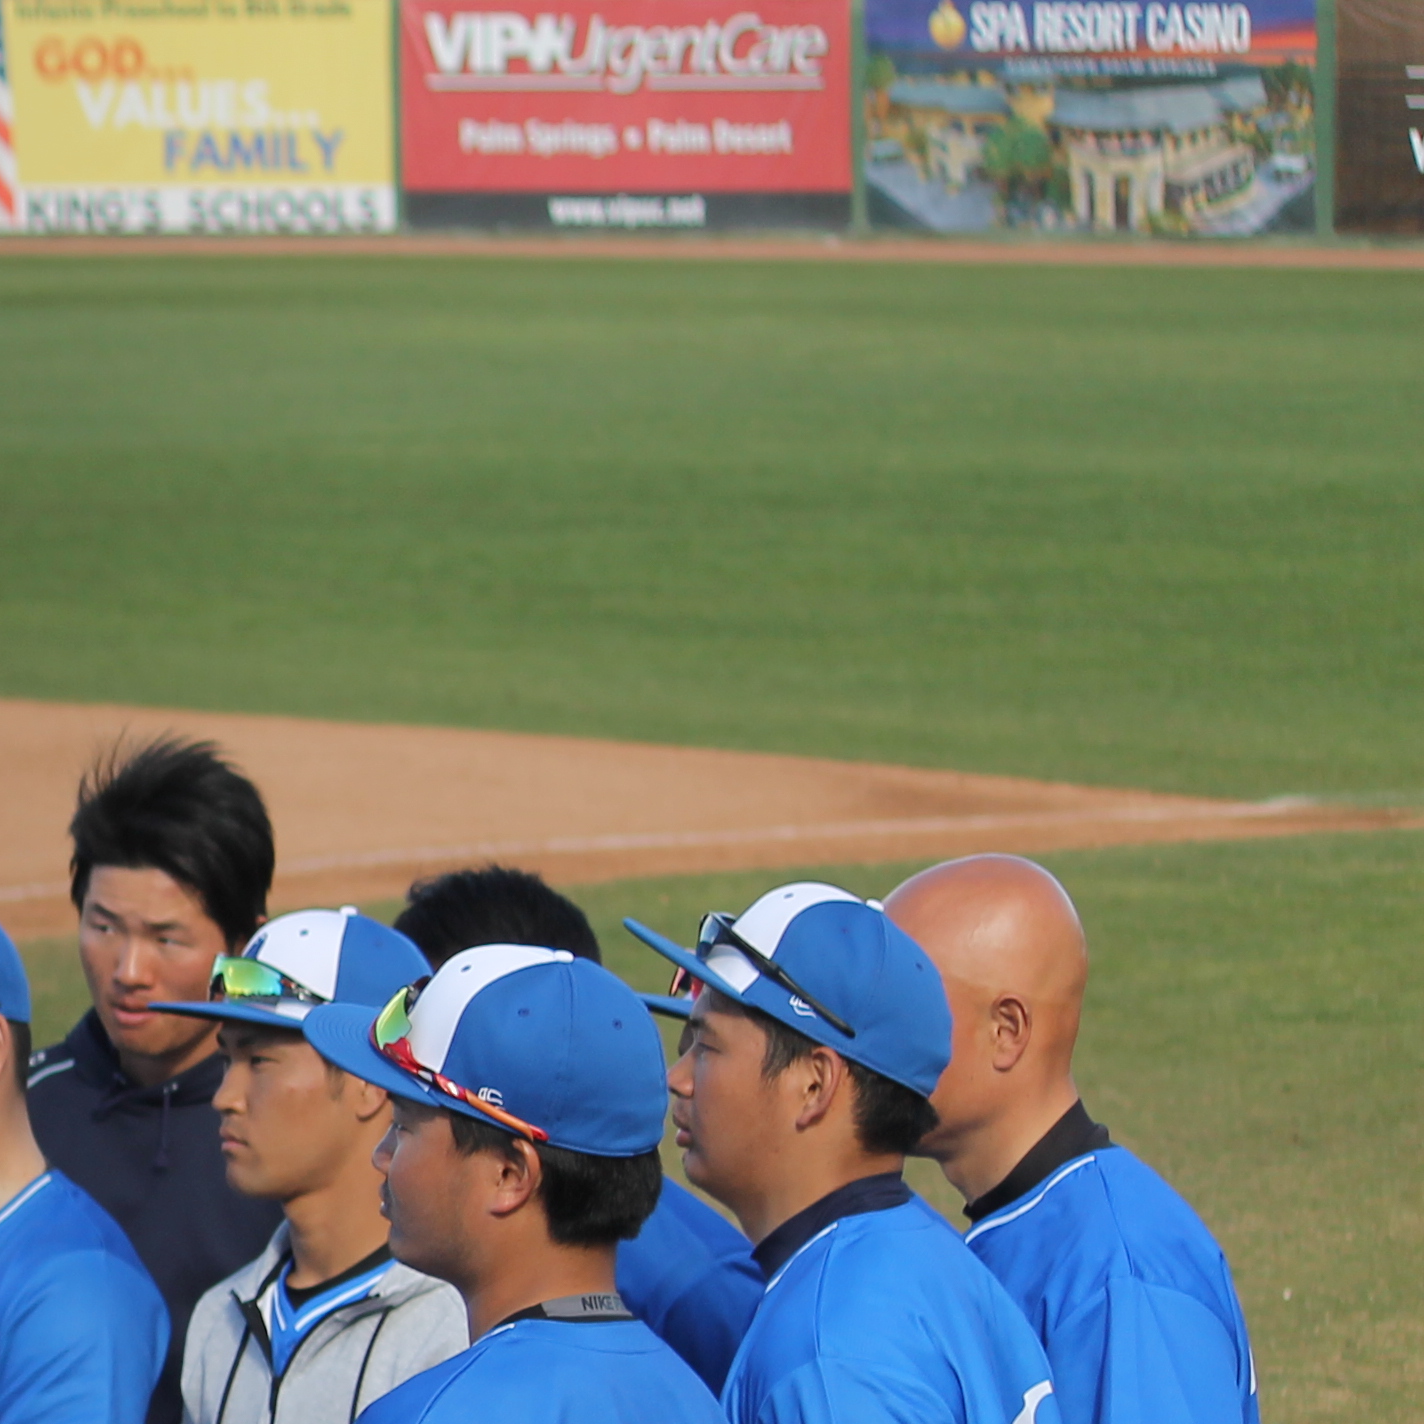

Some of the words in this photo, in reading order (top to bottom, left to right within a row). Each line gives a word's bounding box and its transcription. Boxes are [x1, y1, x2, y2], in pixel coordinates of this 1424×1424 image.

[969, 1, 1030, 51] SPA
[1034, 1, 1142, 52] RESORT
[1145, 1, 1251, 53] CASINO
[557, 12, 830, 94] UrgentCare
[163, 128, 346, 174] FAMILY
[458, 118, 525, 153] Palm
[526, 117, 618, 158] Springs
[646, 118, 711, 153] Palm
[712, 117, 794, 154] Desert
[24, 189, 163, 231] KING'S
[187, 189, 381, 231] SCHOOLS
